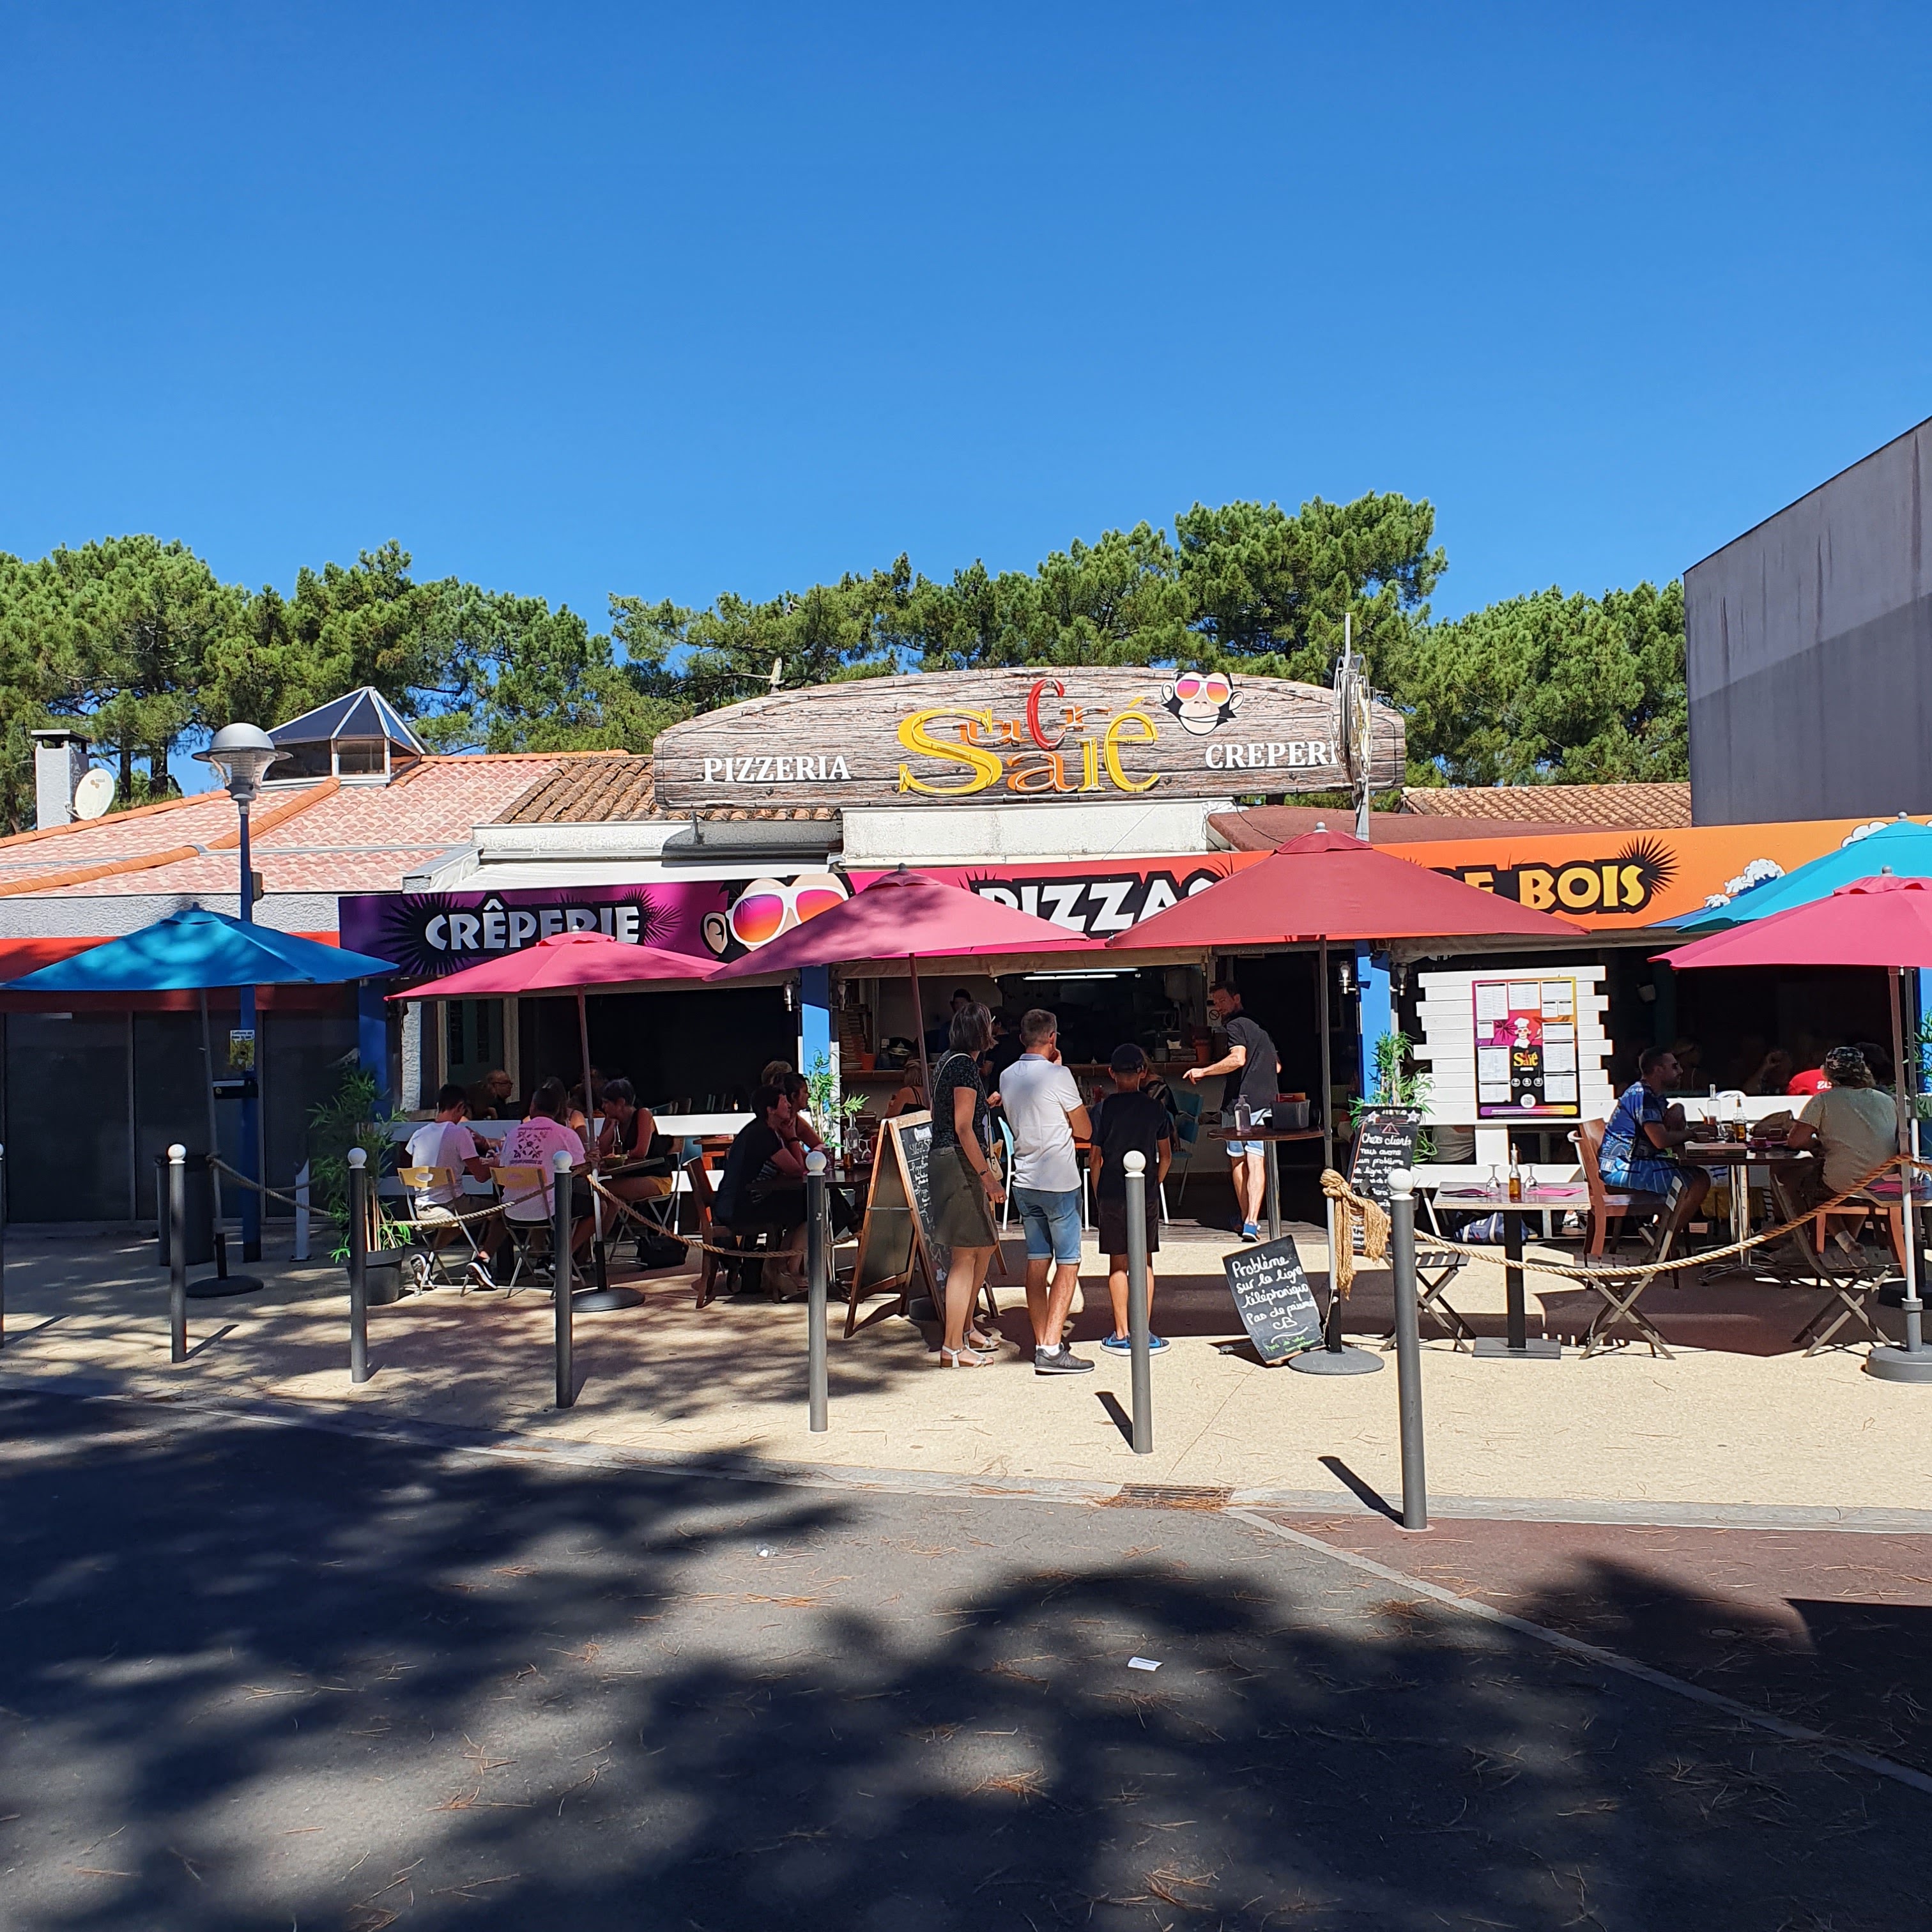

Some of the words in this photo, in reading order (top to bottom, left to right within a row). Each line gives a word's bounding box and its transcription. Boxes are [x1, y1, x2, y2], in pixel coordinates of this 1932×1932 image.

[1205, 740, 1344, 769] CREPERI
[703, 755, 852, 783] PIZZERIA
[1519, 864, 1646, 910] BOIS
[979, 878, 1214, 931] IZZA
[1231, 1254, 1289, 1278] Problème
[1236, 1278, 1254, 1294] sur
[1258, 1274, 1273, 1287] la
[1276, 1266, 1303, 1284] ligne
[1246, 1312, 1267, 1325] Pas
[1269, 1305, 1285, 1318] de
